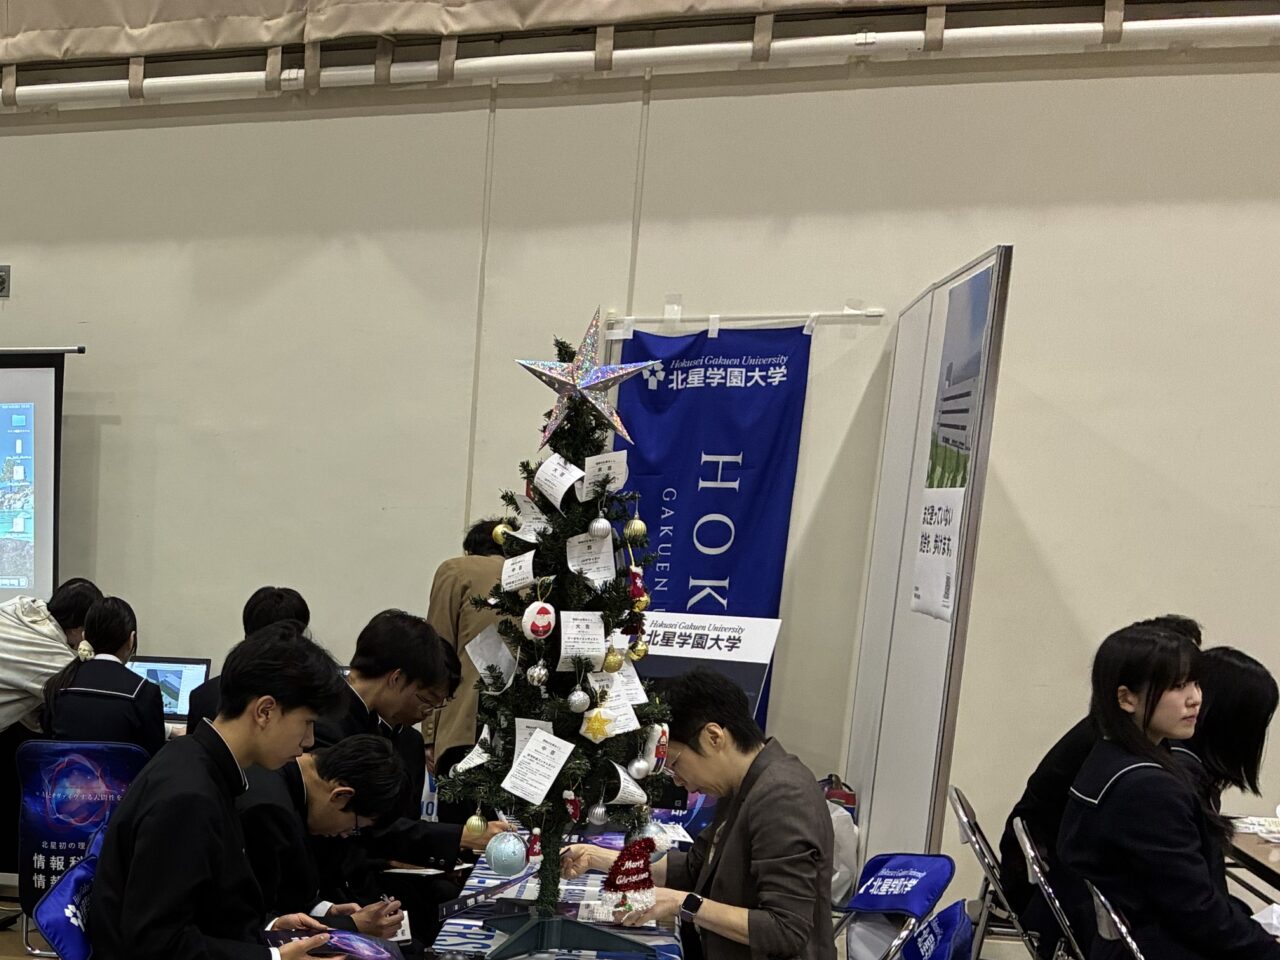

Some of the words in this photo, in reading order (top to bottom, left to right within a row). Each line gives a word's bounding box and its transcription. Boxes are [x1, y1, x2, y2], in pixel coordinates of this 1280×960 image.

[671, 356, 704, 368] Hokusei
[705, 355, 740, 365] Gakuen
[742, 354, 788, 365] University
[668, 366, 787, 390] 北星学園大学
[654, 487, 677, 591] GAKUEN
[650, 620, 678, 630] Hokusei
[678, 622, 707, 632] Gakuen
[708, 624, 745, 634] University
[647, 630, 742, 652] 北星学園大学
